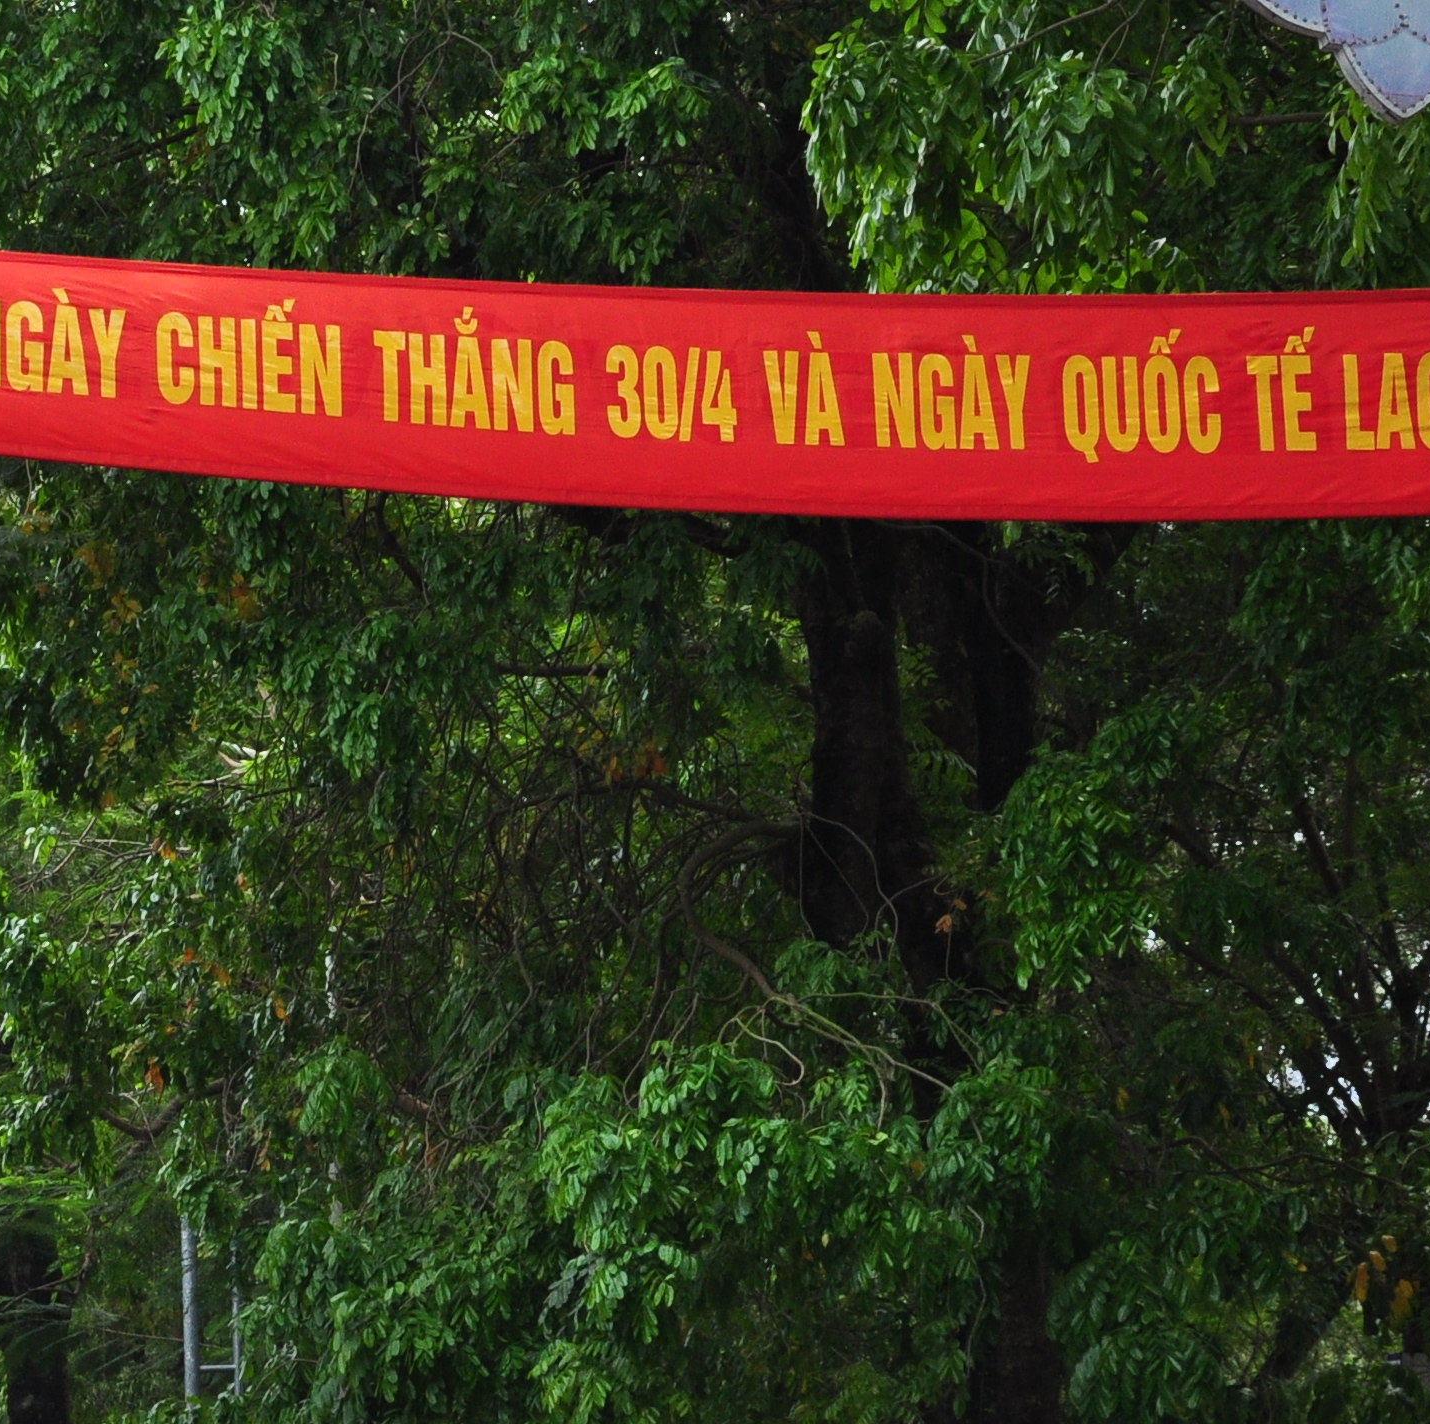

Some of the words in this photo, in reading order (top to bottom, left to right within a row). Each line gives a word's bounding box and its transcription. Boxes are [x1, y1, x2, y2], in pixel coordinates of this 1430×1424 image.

[156, 298, 342, 417] CHIẾN
[374, 306, 576, 436] THẮNG
[606, 344, 738, 443] 30/4
[763, 331, 845, 446] VÀ
[871, 335, 1031, 451] NGÀY
[1062, 328, 1222, 463] QUỐC
[1245, 326, 1317, 452] TẾ
